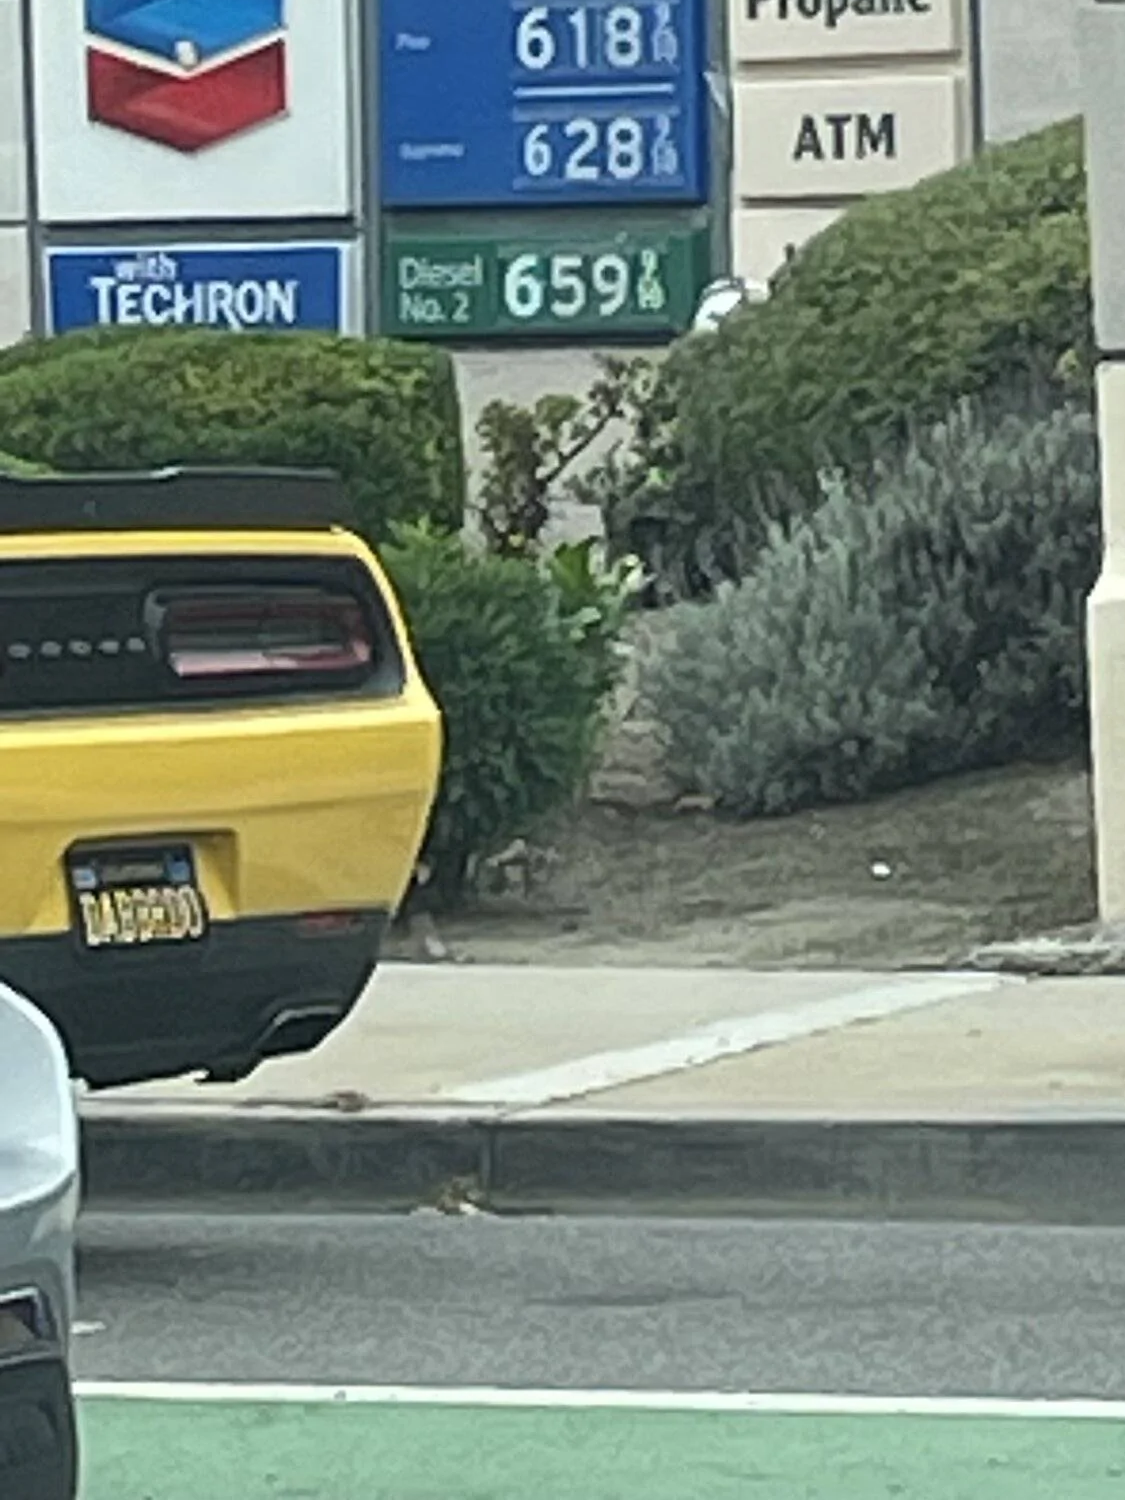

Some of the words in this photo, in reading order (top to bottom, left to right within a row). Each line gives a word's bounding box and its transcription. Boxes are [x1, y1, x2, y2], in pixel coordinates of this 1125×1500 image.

[792, 112, 897, 161] ATM
[113, 252, 178, 280] with
[399, 253, 484, 289] Diesel
[88, 277, 300, 331] TECHRON
[452, 292, 471, 323] 2
